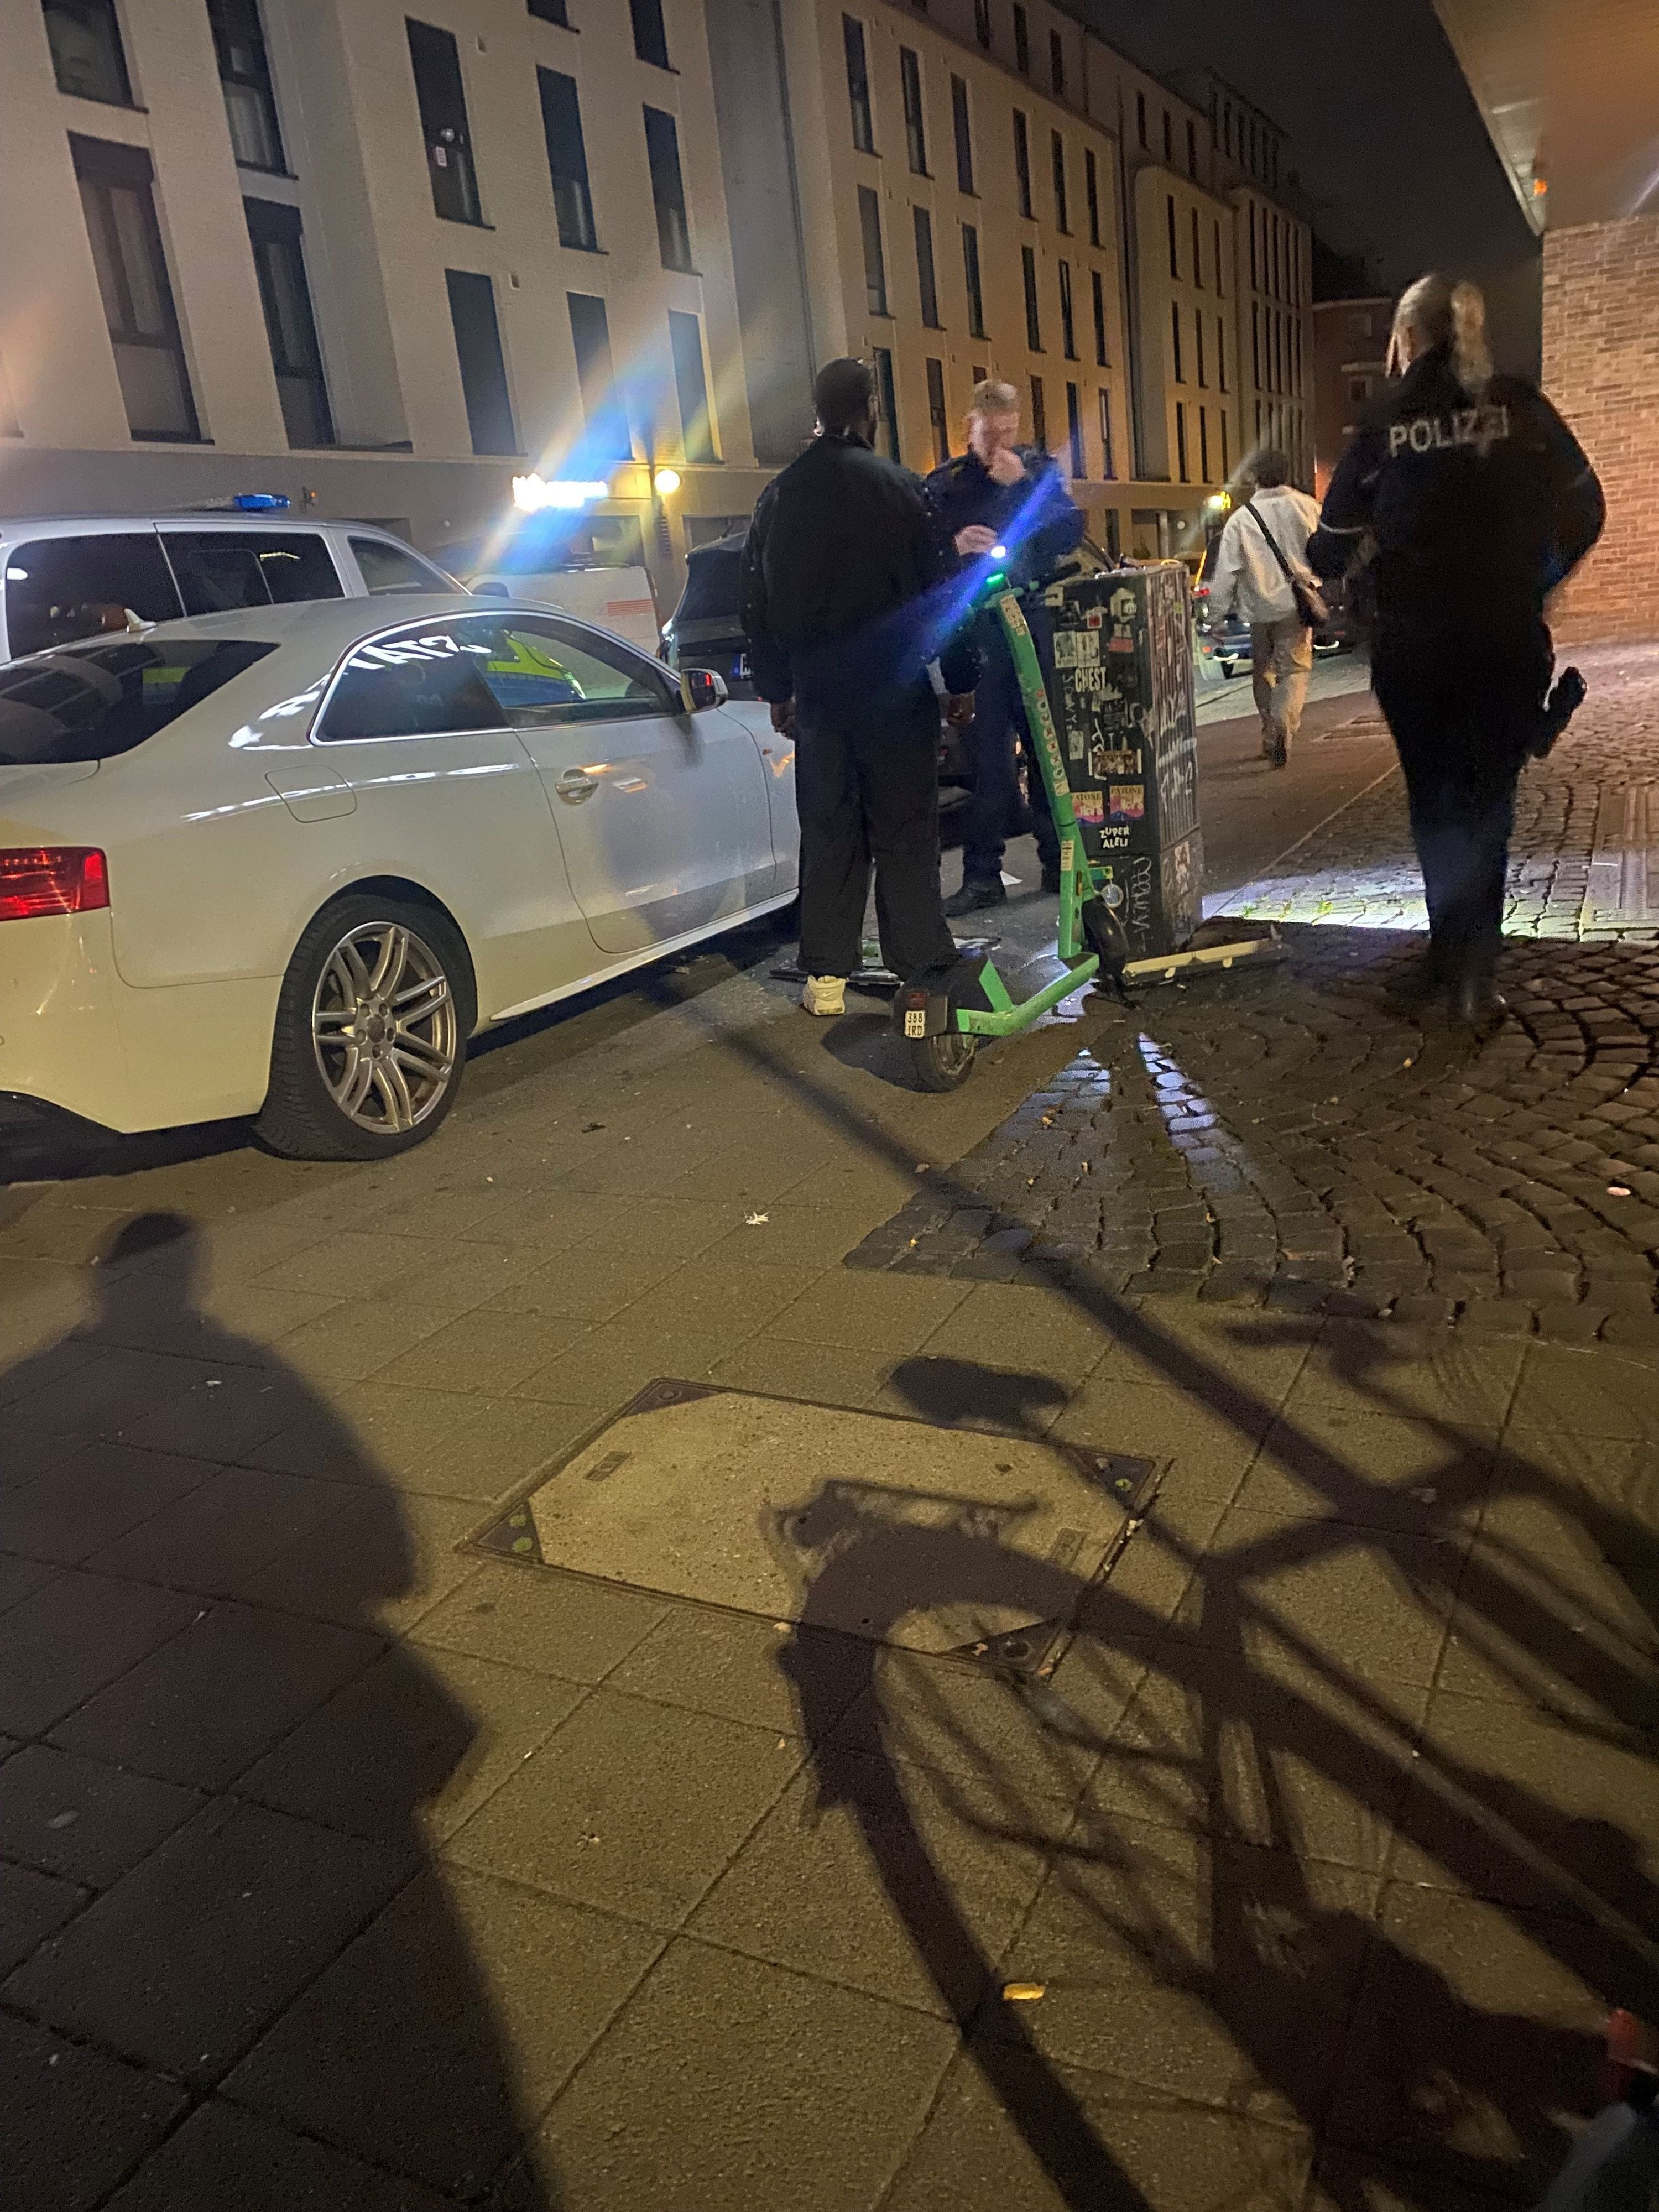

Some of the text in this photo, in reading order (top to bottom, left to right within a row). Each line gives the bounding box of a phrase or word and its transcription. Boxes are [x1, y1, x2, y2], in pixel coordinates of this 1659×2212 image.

[1388, 406, 1509, 458] POLIZI
[1075, 667, 1106, 692] CHEST
[907, 1013, 922, 1023] 388
[907, 1025, 922, 1036] IRD
